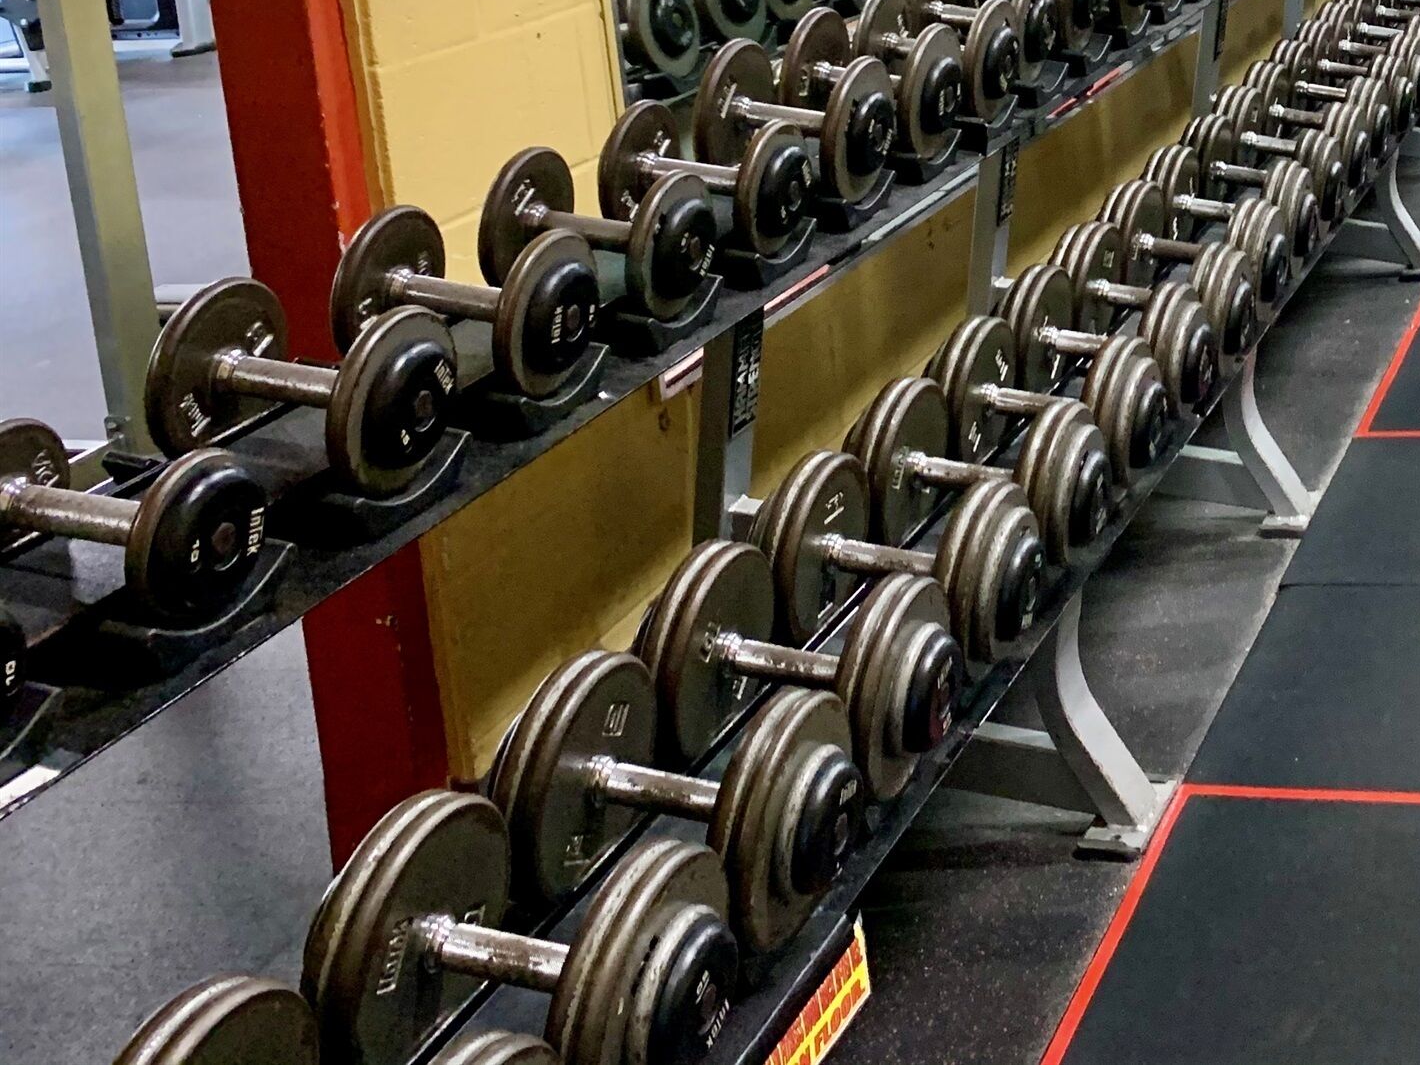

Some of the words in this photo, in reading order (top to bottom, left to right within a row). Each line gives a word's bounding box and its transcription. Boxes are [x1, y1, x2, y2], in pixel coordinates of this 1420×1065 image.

[246, 506, 265, 557] InTek
[706, 997, 730, 1049] InTek
[813, 978, 866, 1059] FLOOR
